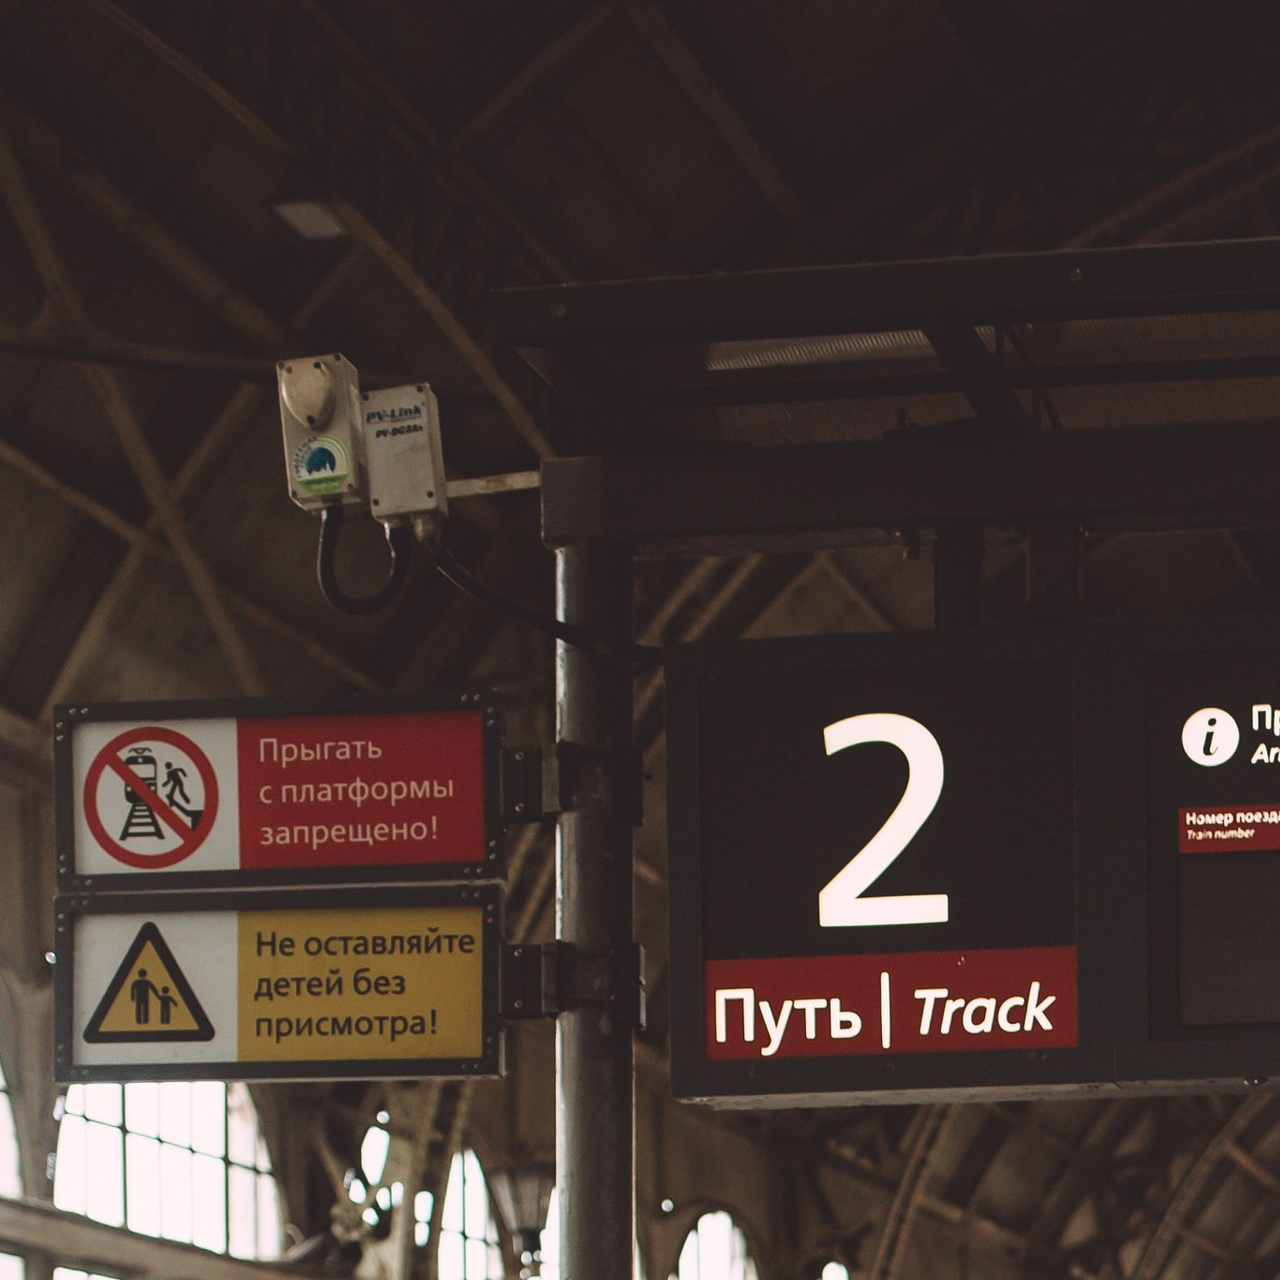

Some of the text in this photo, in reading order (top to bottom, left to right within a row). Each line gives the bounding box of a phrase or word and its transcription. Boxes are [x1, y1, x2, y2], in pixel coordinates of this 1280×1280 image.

[259, 737, 382, 769] Прыгать
[259, 776, 454, 808] с платформы
[260, 815, 438, 850] запрещено!
[818, 712, 949, 928] 2
[1185, 811, 1234, 827] Номер
[1186, 827, 1255, 840] Train number
[256, 926, 476, 957] Не оставляйте
[253, 967, 407, 1001] детей без
[255, 1008, 437, 1044] присмотра!
[715, 987, 863, 1057] Путь
[913, 980, 1057, 1036] Track
